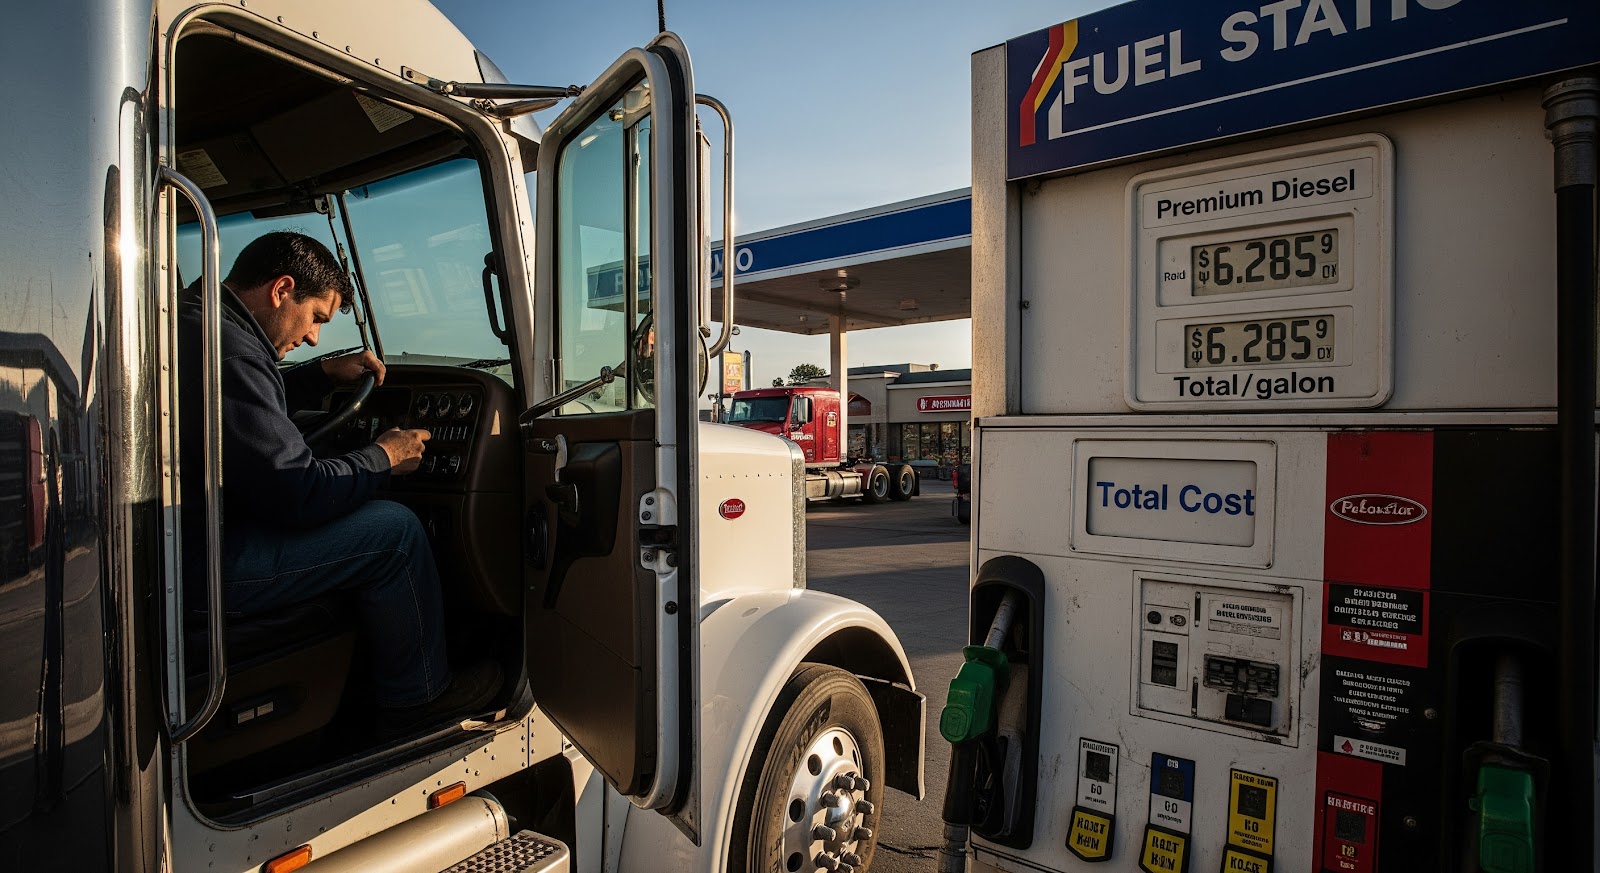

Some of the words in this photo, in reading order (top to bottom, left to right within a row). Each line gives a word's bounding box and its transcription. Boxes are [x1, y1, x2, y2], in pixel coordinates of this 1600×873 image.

[1063, 29, 1202, 105] FUEL
[1220, 0, 1462, 62] STA
[1157, 189, 1263, 219] Premium
[1272, 169, 1355, 202] Diesel
[1097, 481, 1168, 510] Total
[1179, 484, 1255, 516] Cost
